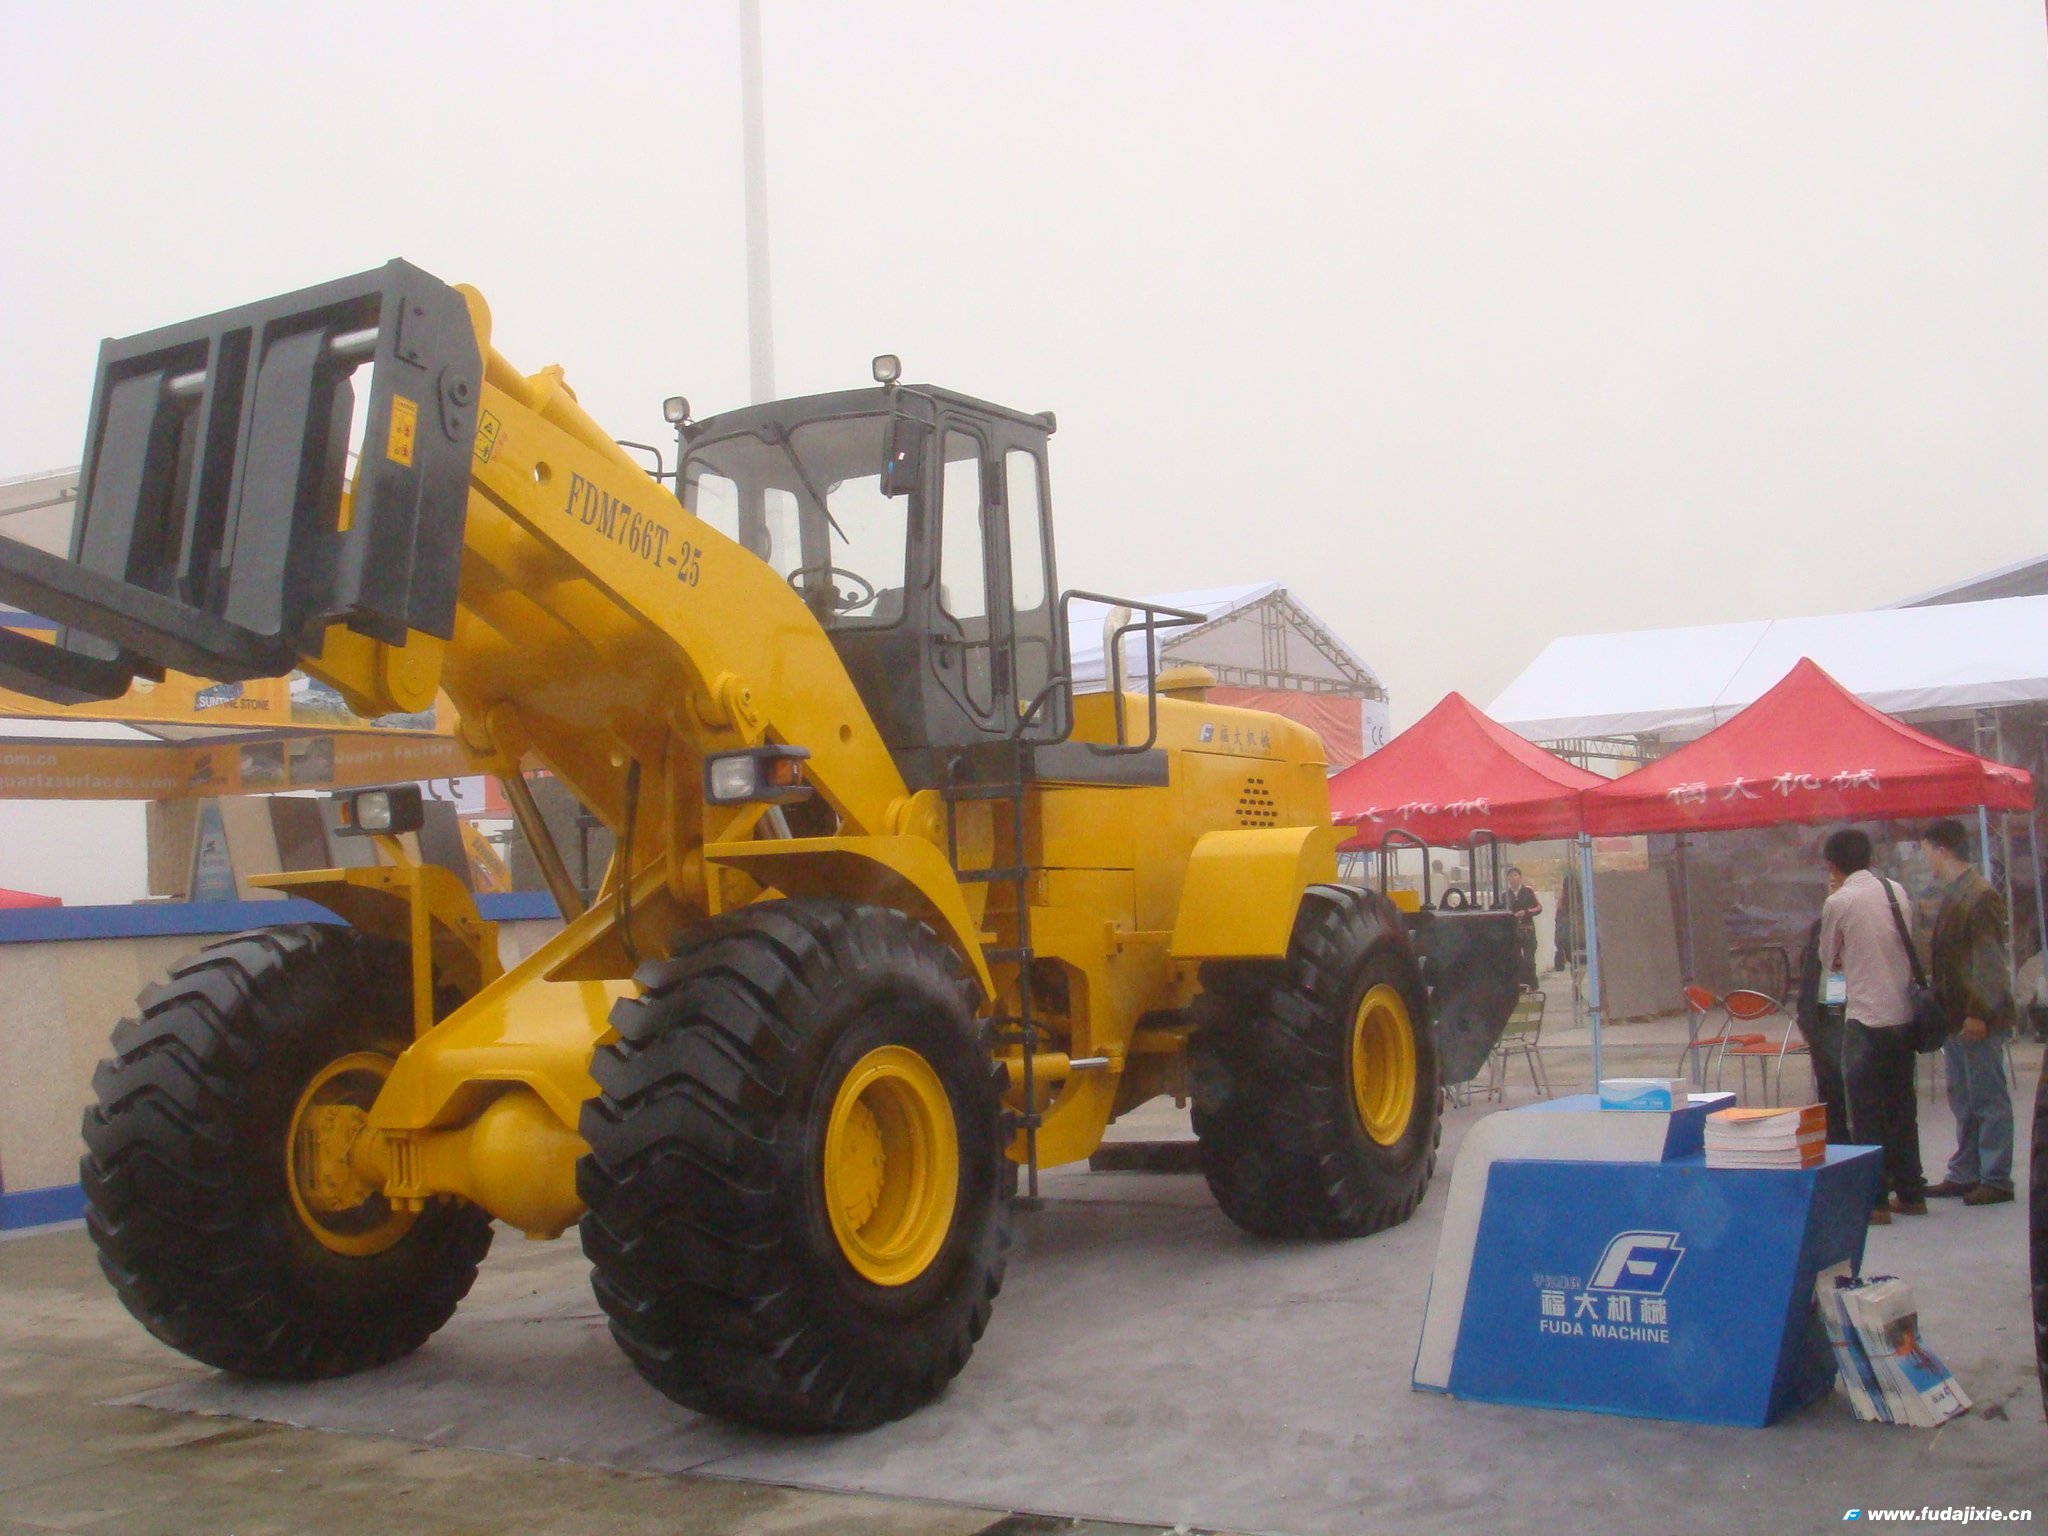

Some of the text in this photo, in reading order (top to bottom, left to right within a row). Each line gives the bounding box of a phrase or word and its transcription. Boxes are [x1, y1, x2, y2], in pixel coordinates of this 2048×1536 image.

[565, 472, 703, 588] FDM766T-25
[240, 699, 270, 711] STONE
[1666, 769, 1881, 806] 福大机械
[1541, 1289, 1668, 1325] 福大机械
[1540, 1319, 1670, 1344] FUDA MACHINE
